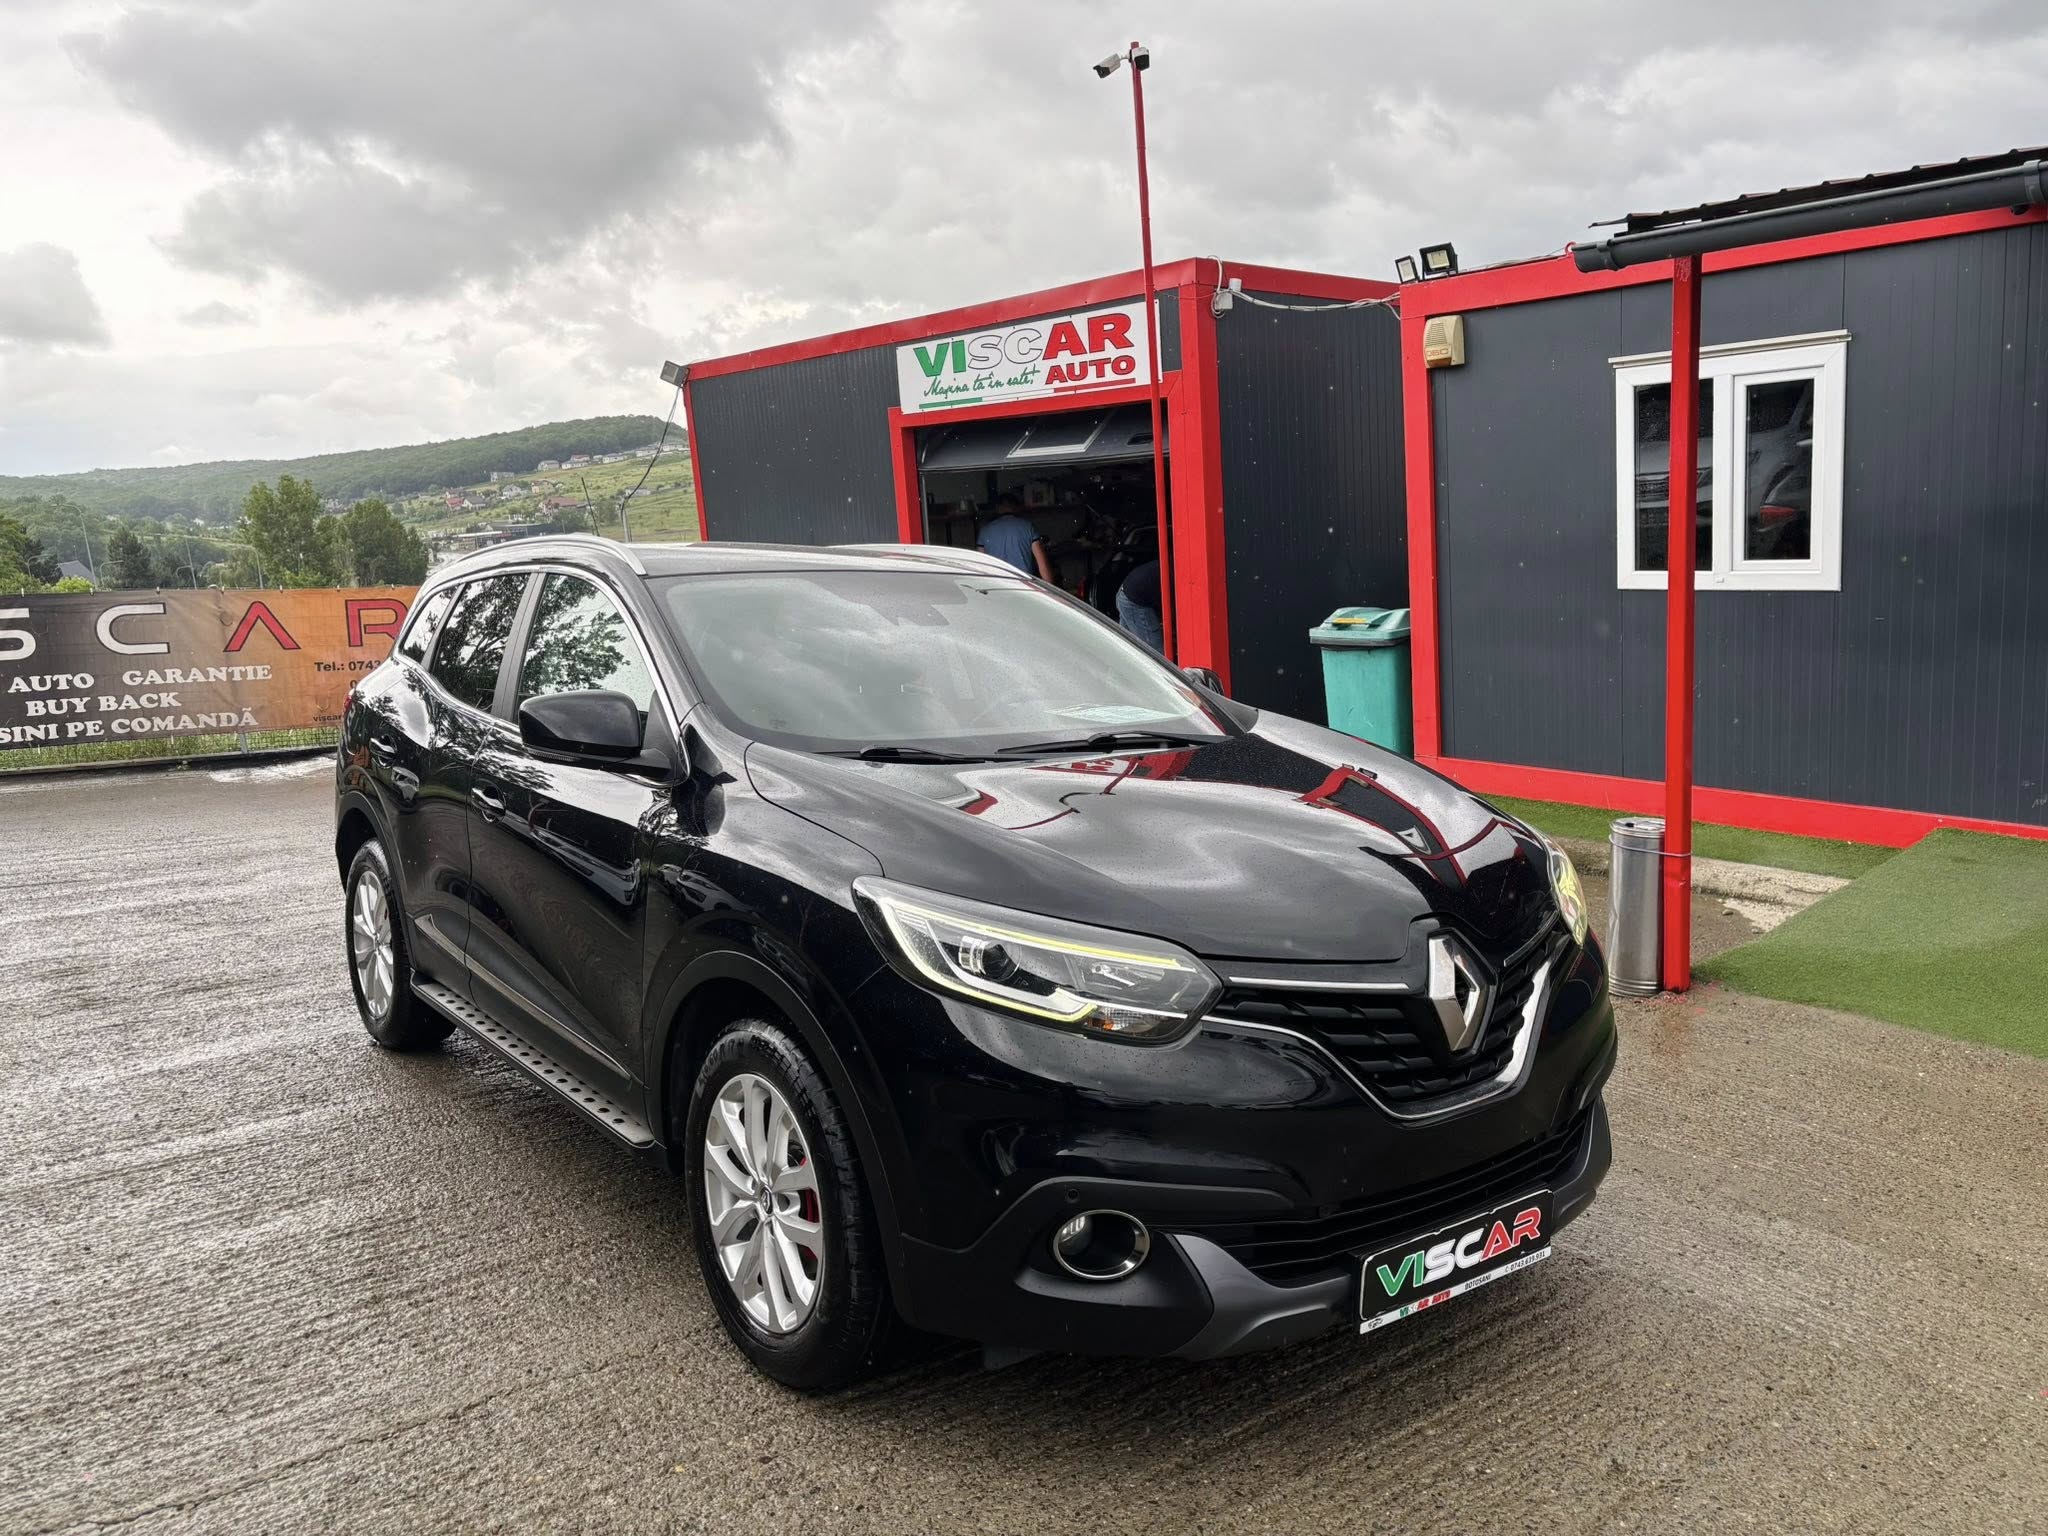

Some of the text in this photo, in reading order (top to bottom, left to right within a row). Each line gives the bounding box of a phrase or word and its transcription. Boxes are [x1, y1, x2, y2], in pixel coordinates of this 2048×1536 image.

[913, 313, 1135, 377] VISCAR
[1045, 355, 1136, 385] AUTO
[8, 665, 273, 693] AUTO GARANTIE
[314, 661, 345, 672] Tel.:
[25, 691, 182, 716] BUY BACK
[65, 720, 105, 737] PE
[1376, 1207, 1542, 1296] VISCAR
